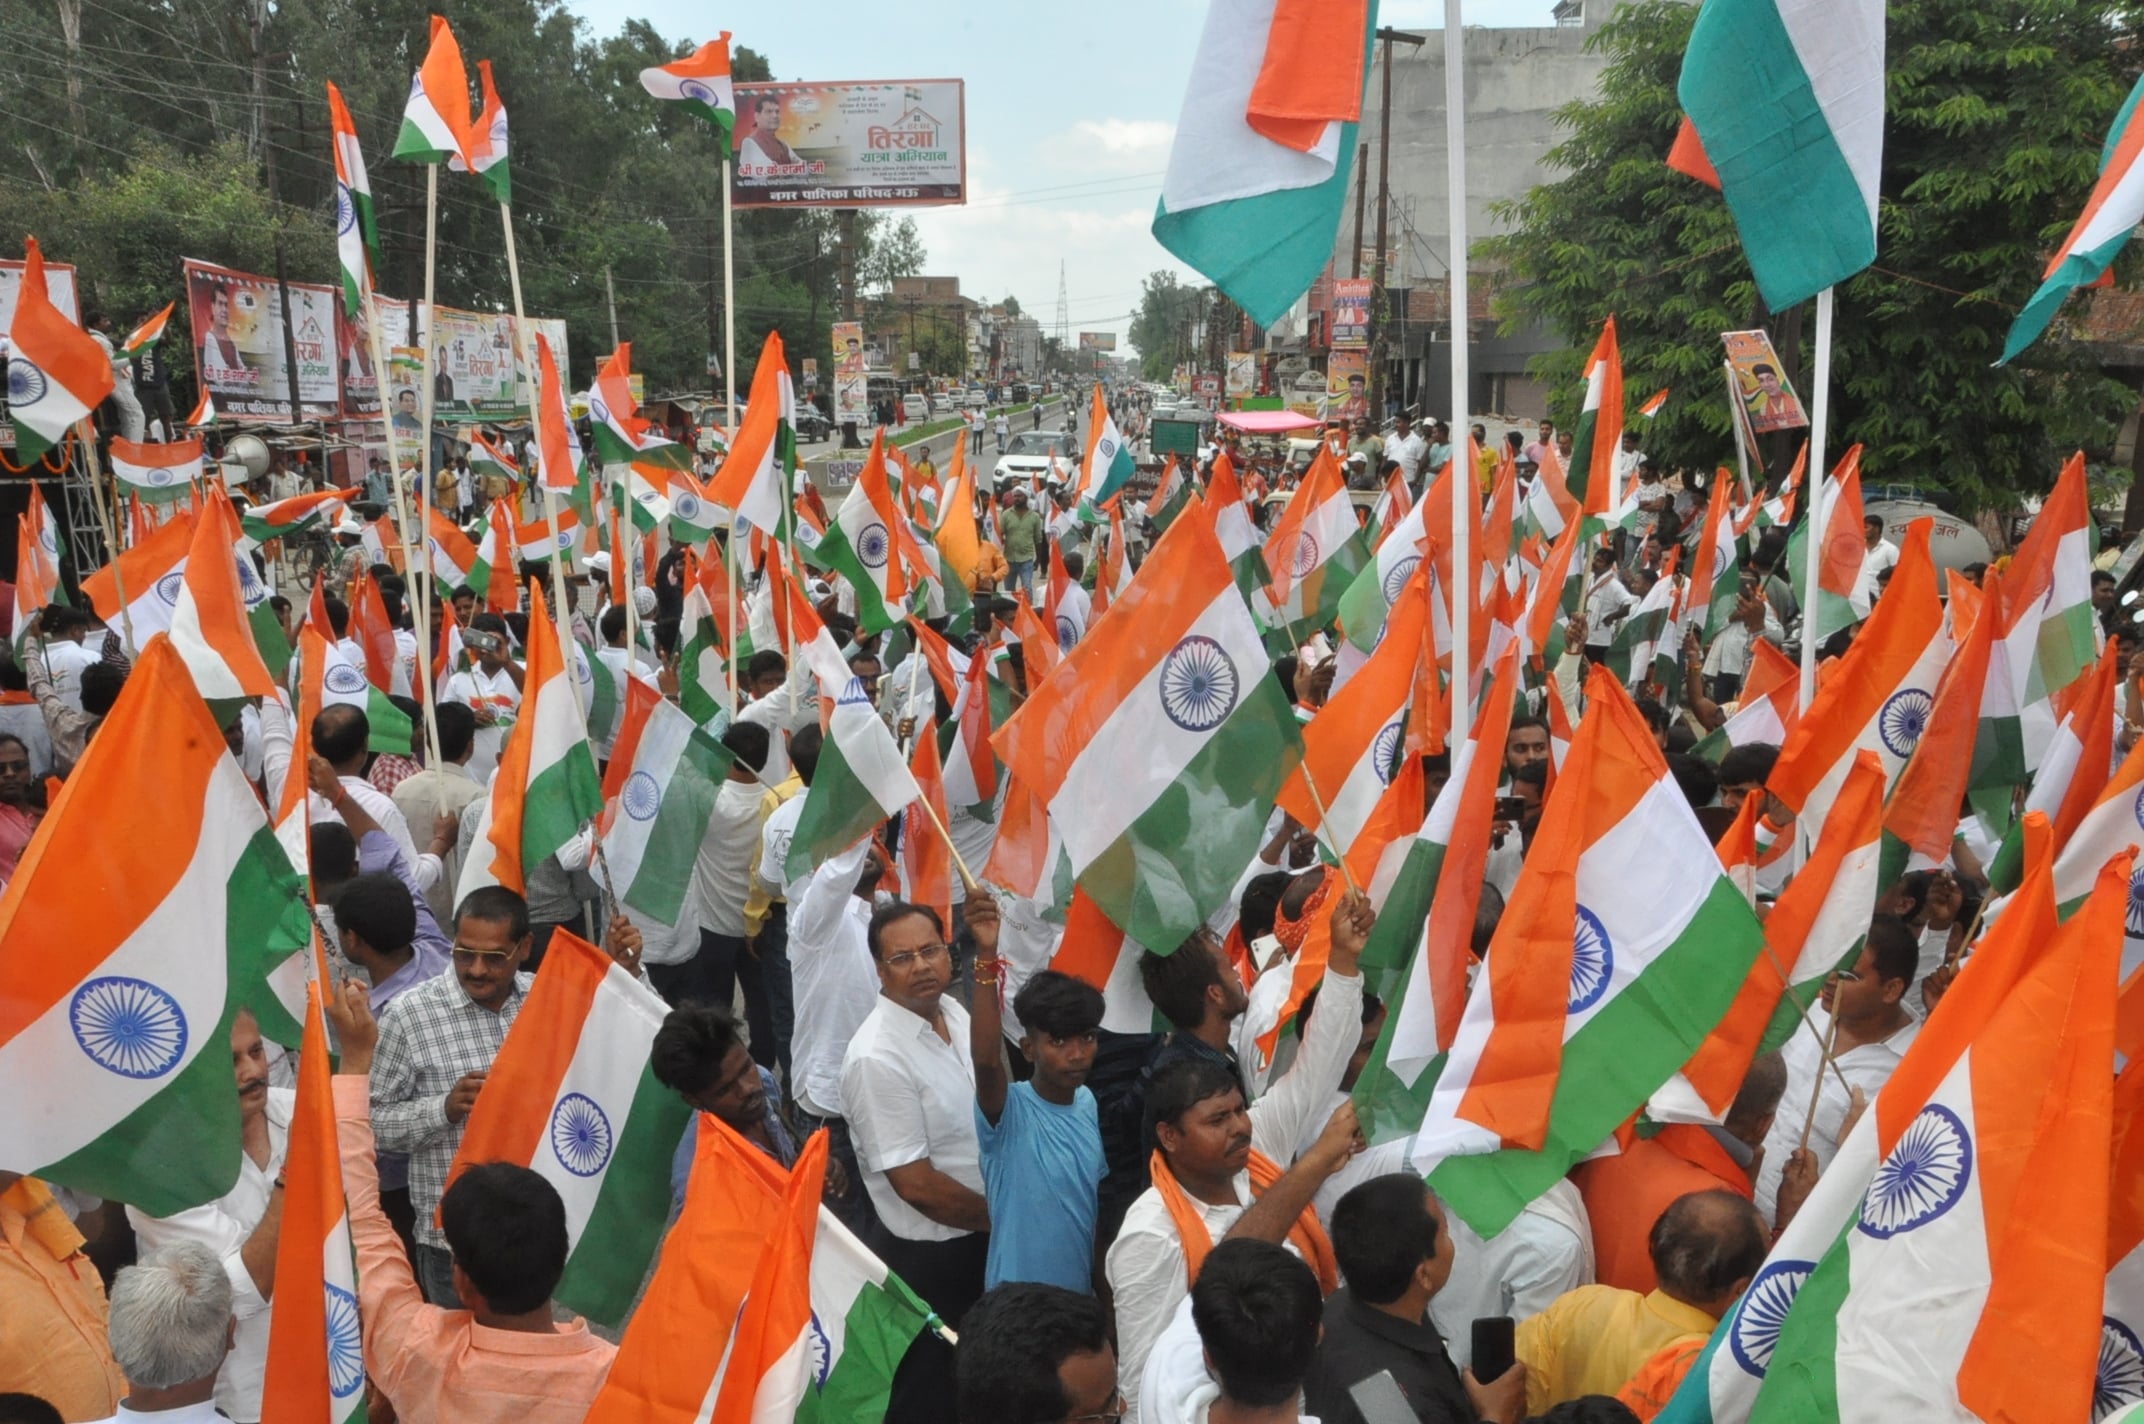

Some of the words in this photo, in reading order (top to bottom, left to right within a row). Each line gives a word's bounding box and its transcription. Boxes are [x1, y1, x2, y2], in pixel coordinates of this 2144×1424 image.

[868, 126, 934, 149] तिरंगा
[860, 151, 890, 162] यात्रा
[895, 149, 948, 162] अभियान
[809, 160, 824, 174] जी
[769, 190, 797, 201] नगर
[801, 187, 848, 200] पालिका
